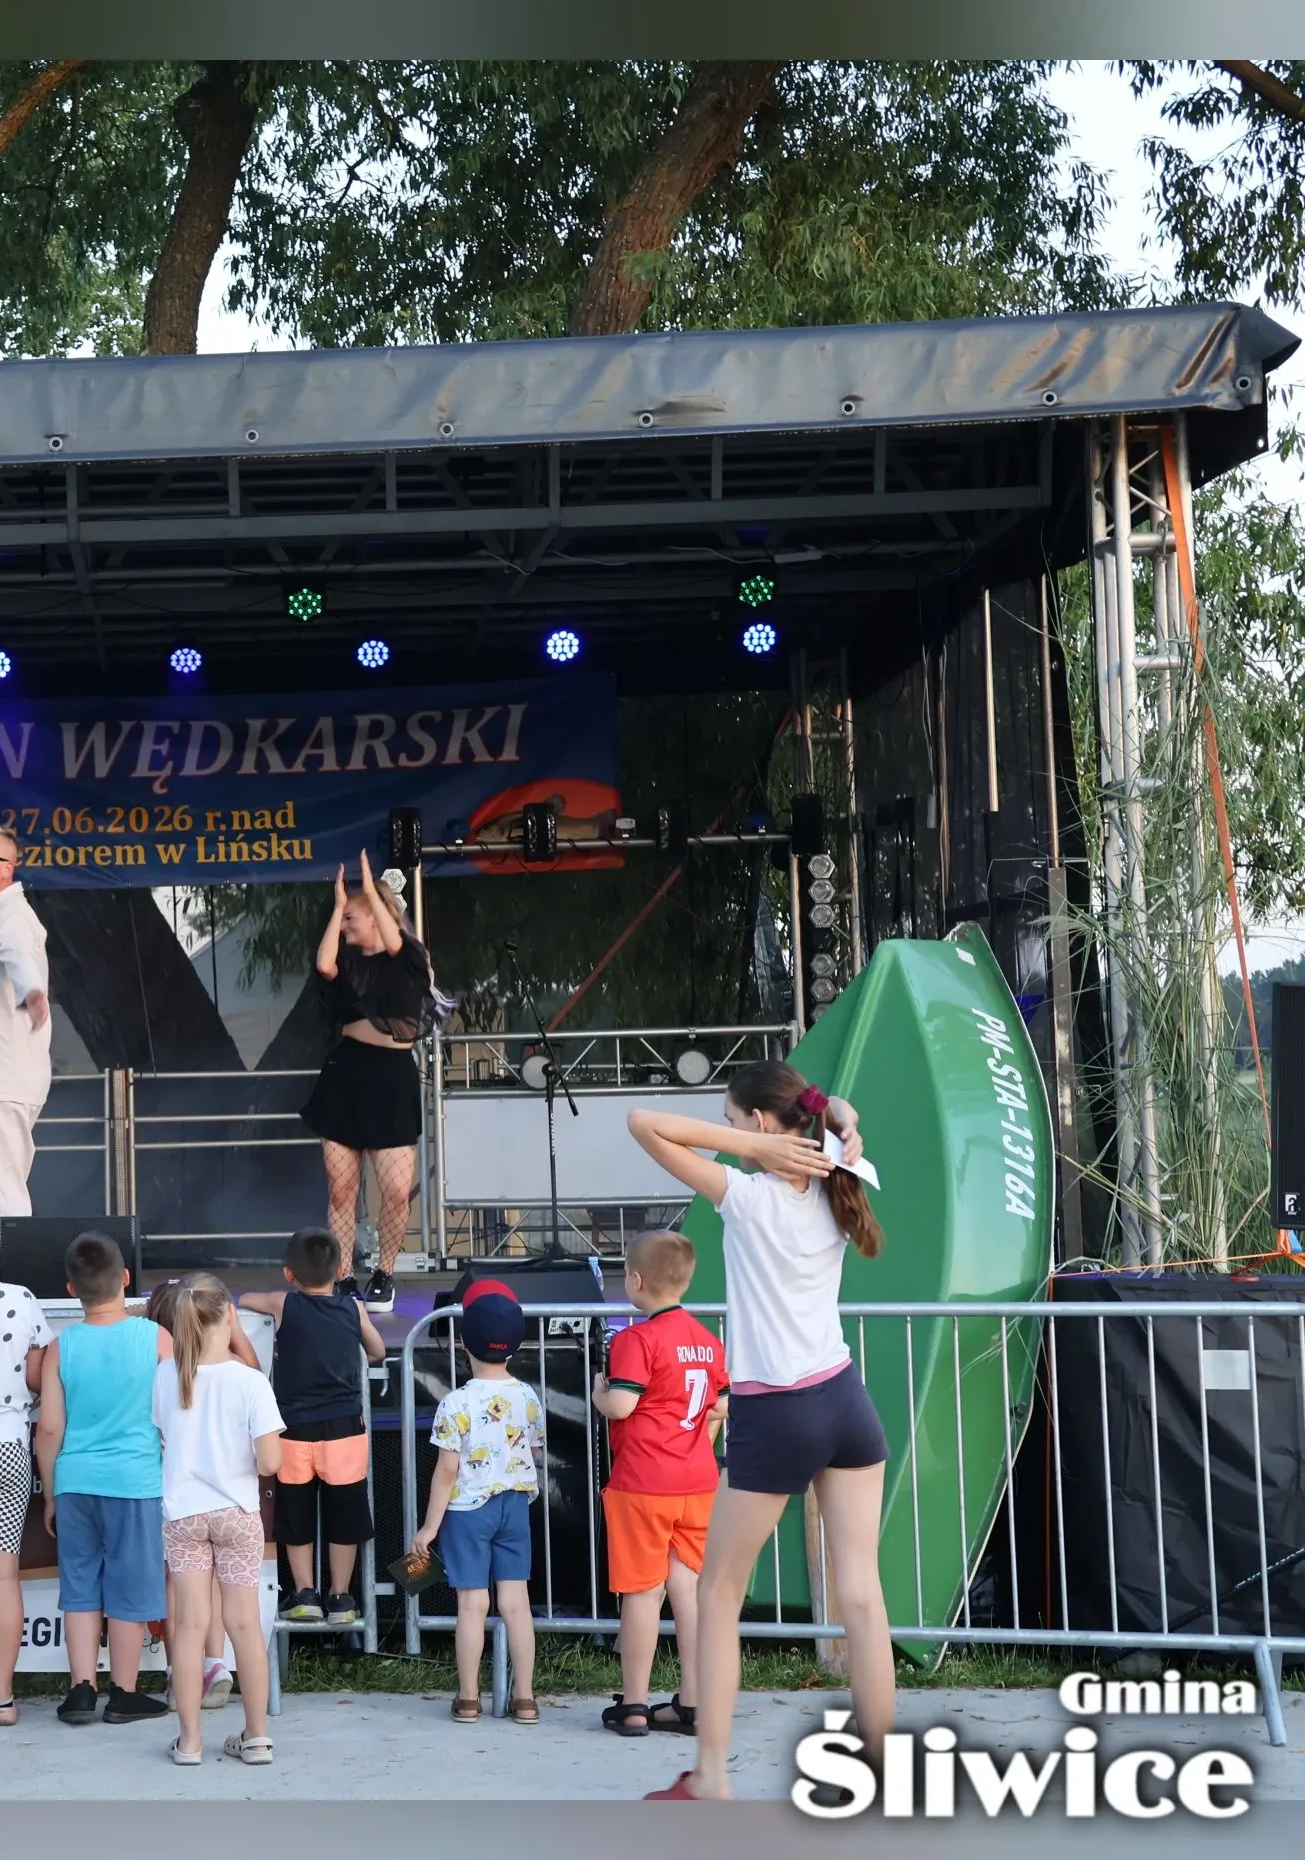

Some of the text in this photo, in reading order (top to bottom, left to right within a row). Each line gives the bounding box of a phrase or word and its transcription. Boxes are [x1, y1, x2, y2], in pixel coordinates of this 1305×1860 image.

[59, 703, 529, 795] WĘDKARSKI
[0, 800, 297, 836] 27.06.2026 r.nad
[155, 843, 185, 865] w
[195, 833, 314, 863] Lińsku
[971, 1007, 1036, 1220] PM-STA-1316A
[679, 1368, 709, 1431] 7
